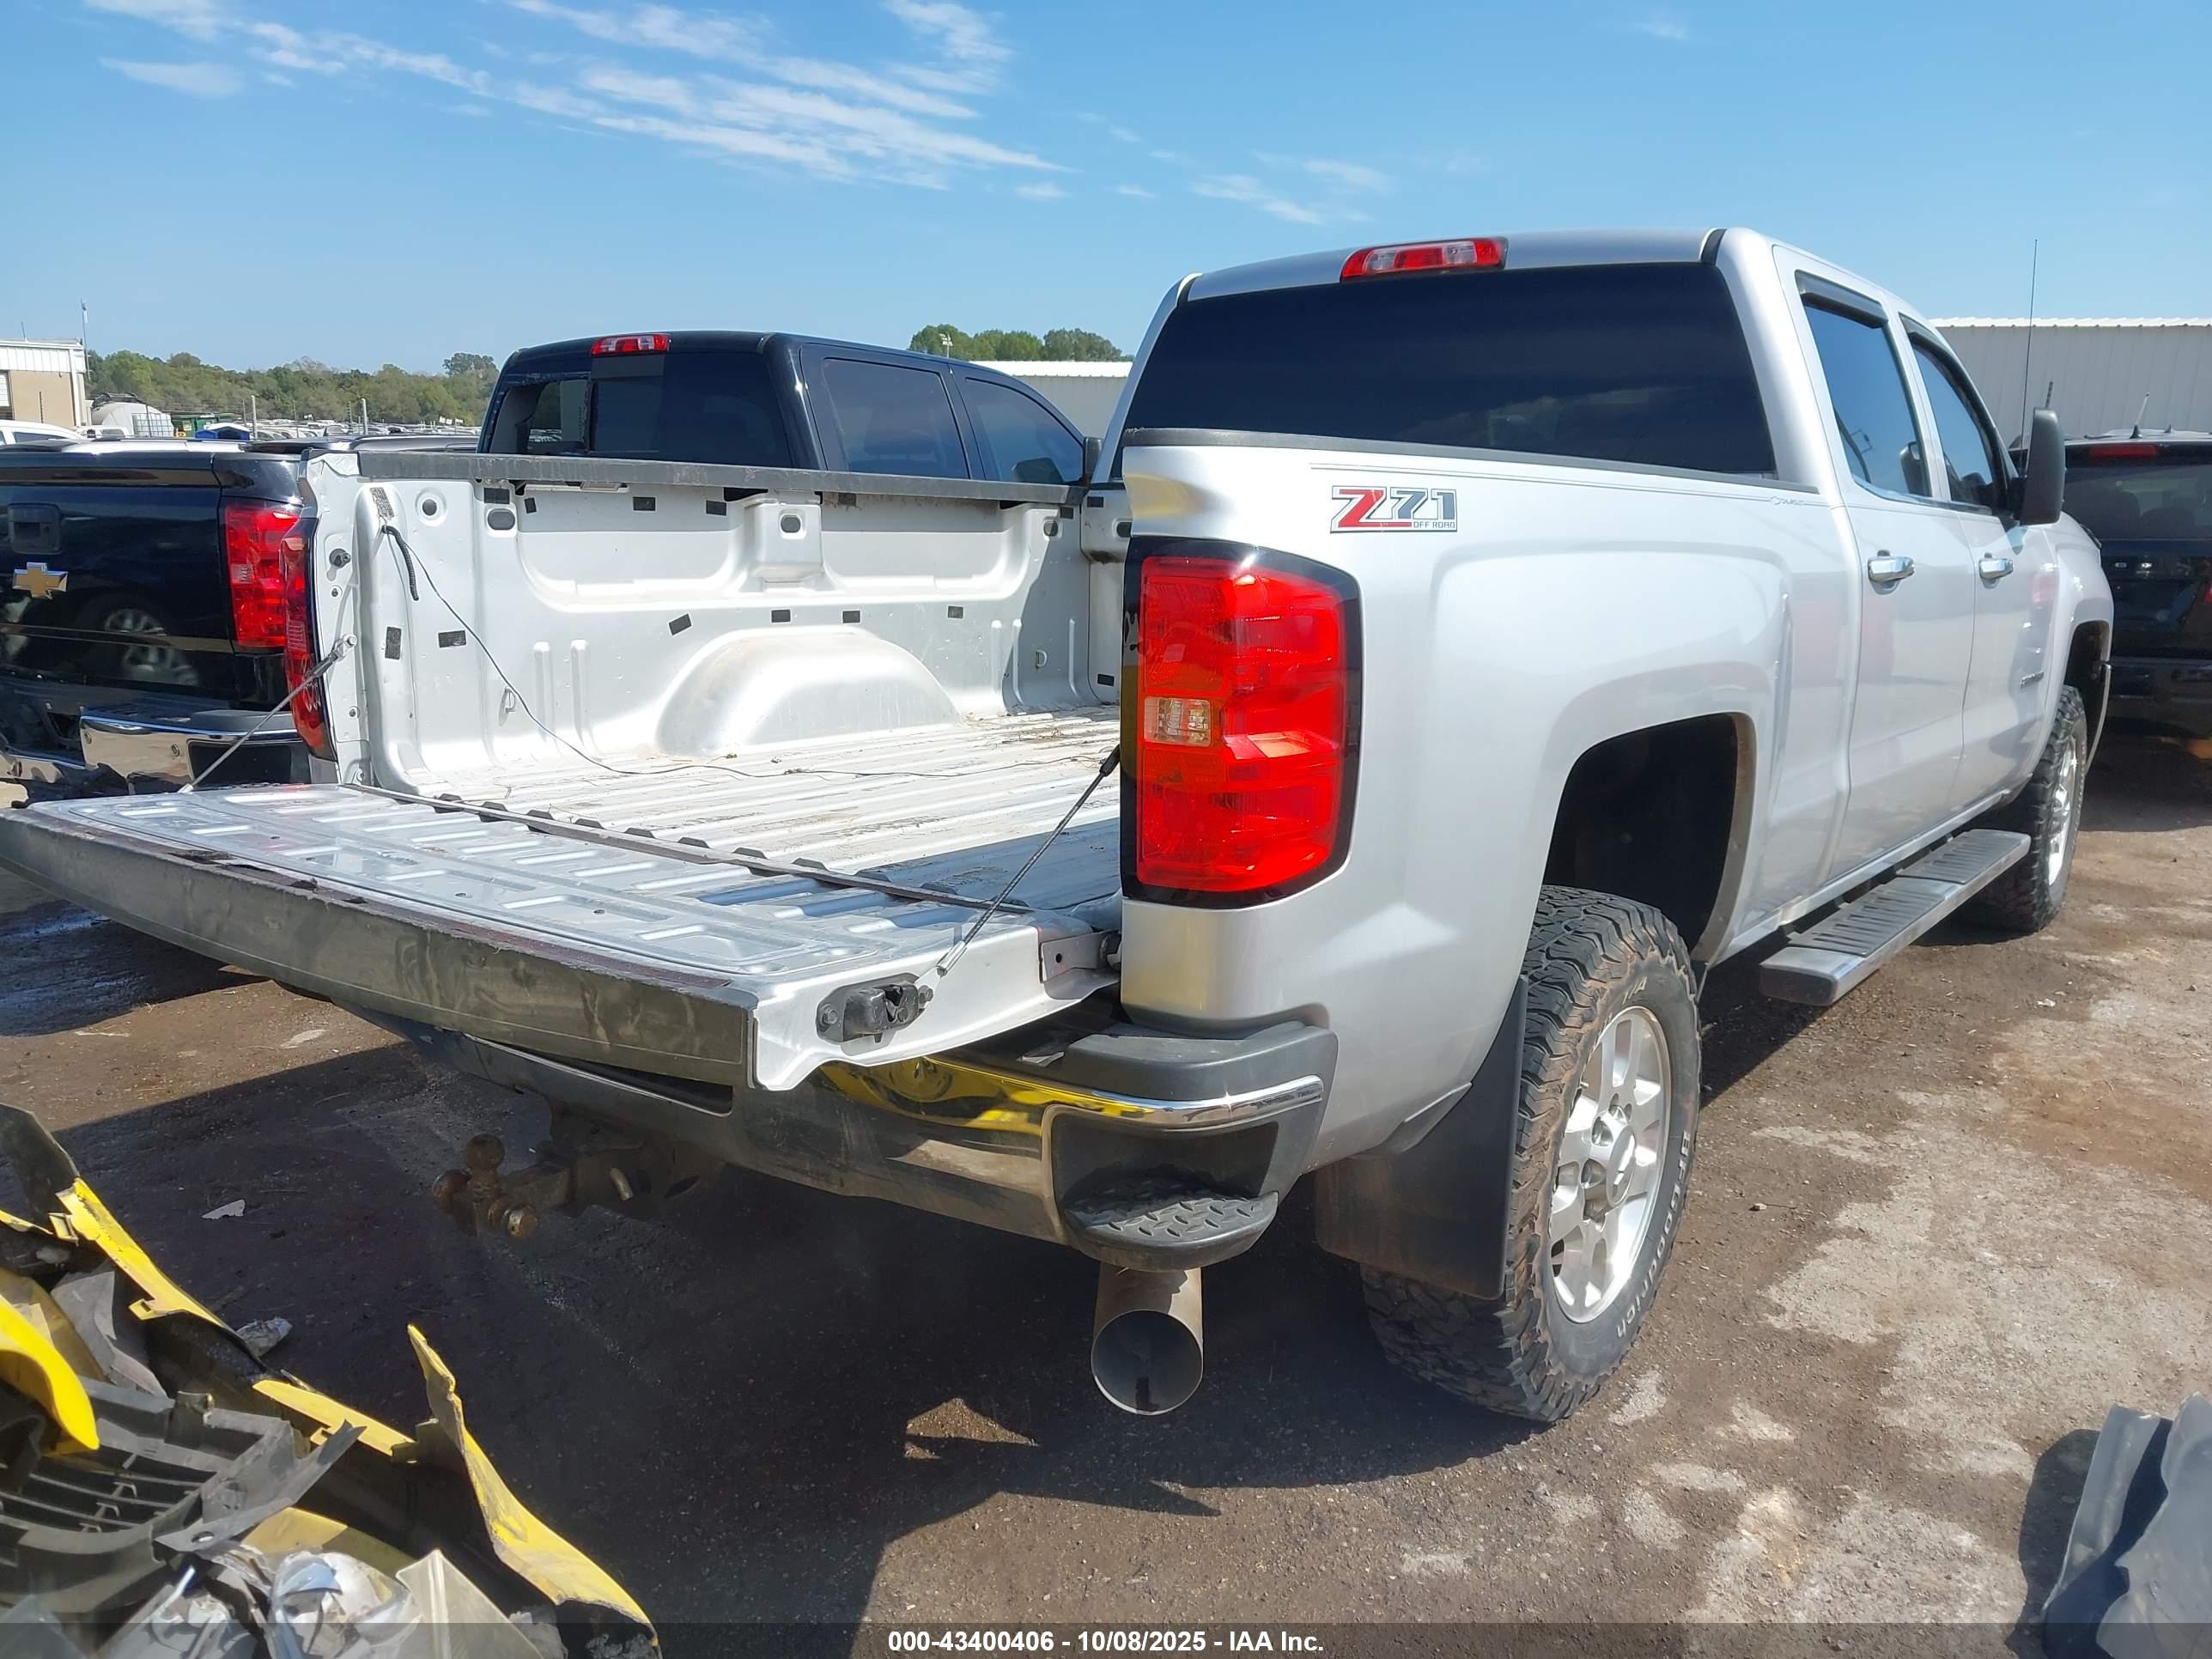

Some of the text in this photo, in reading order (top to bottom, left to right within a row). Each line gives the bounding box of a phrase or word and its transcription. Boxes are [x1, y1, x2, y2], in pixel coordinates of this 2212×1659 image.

[1330, 485, 1458, 532] Z71
[1413, 520, 1455, 529] OFF ROAD
